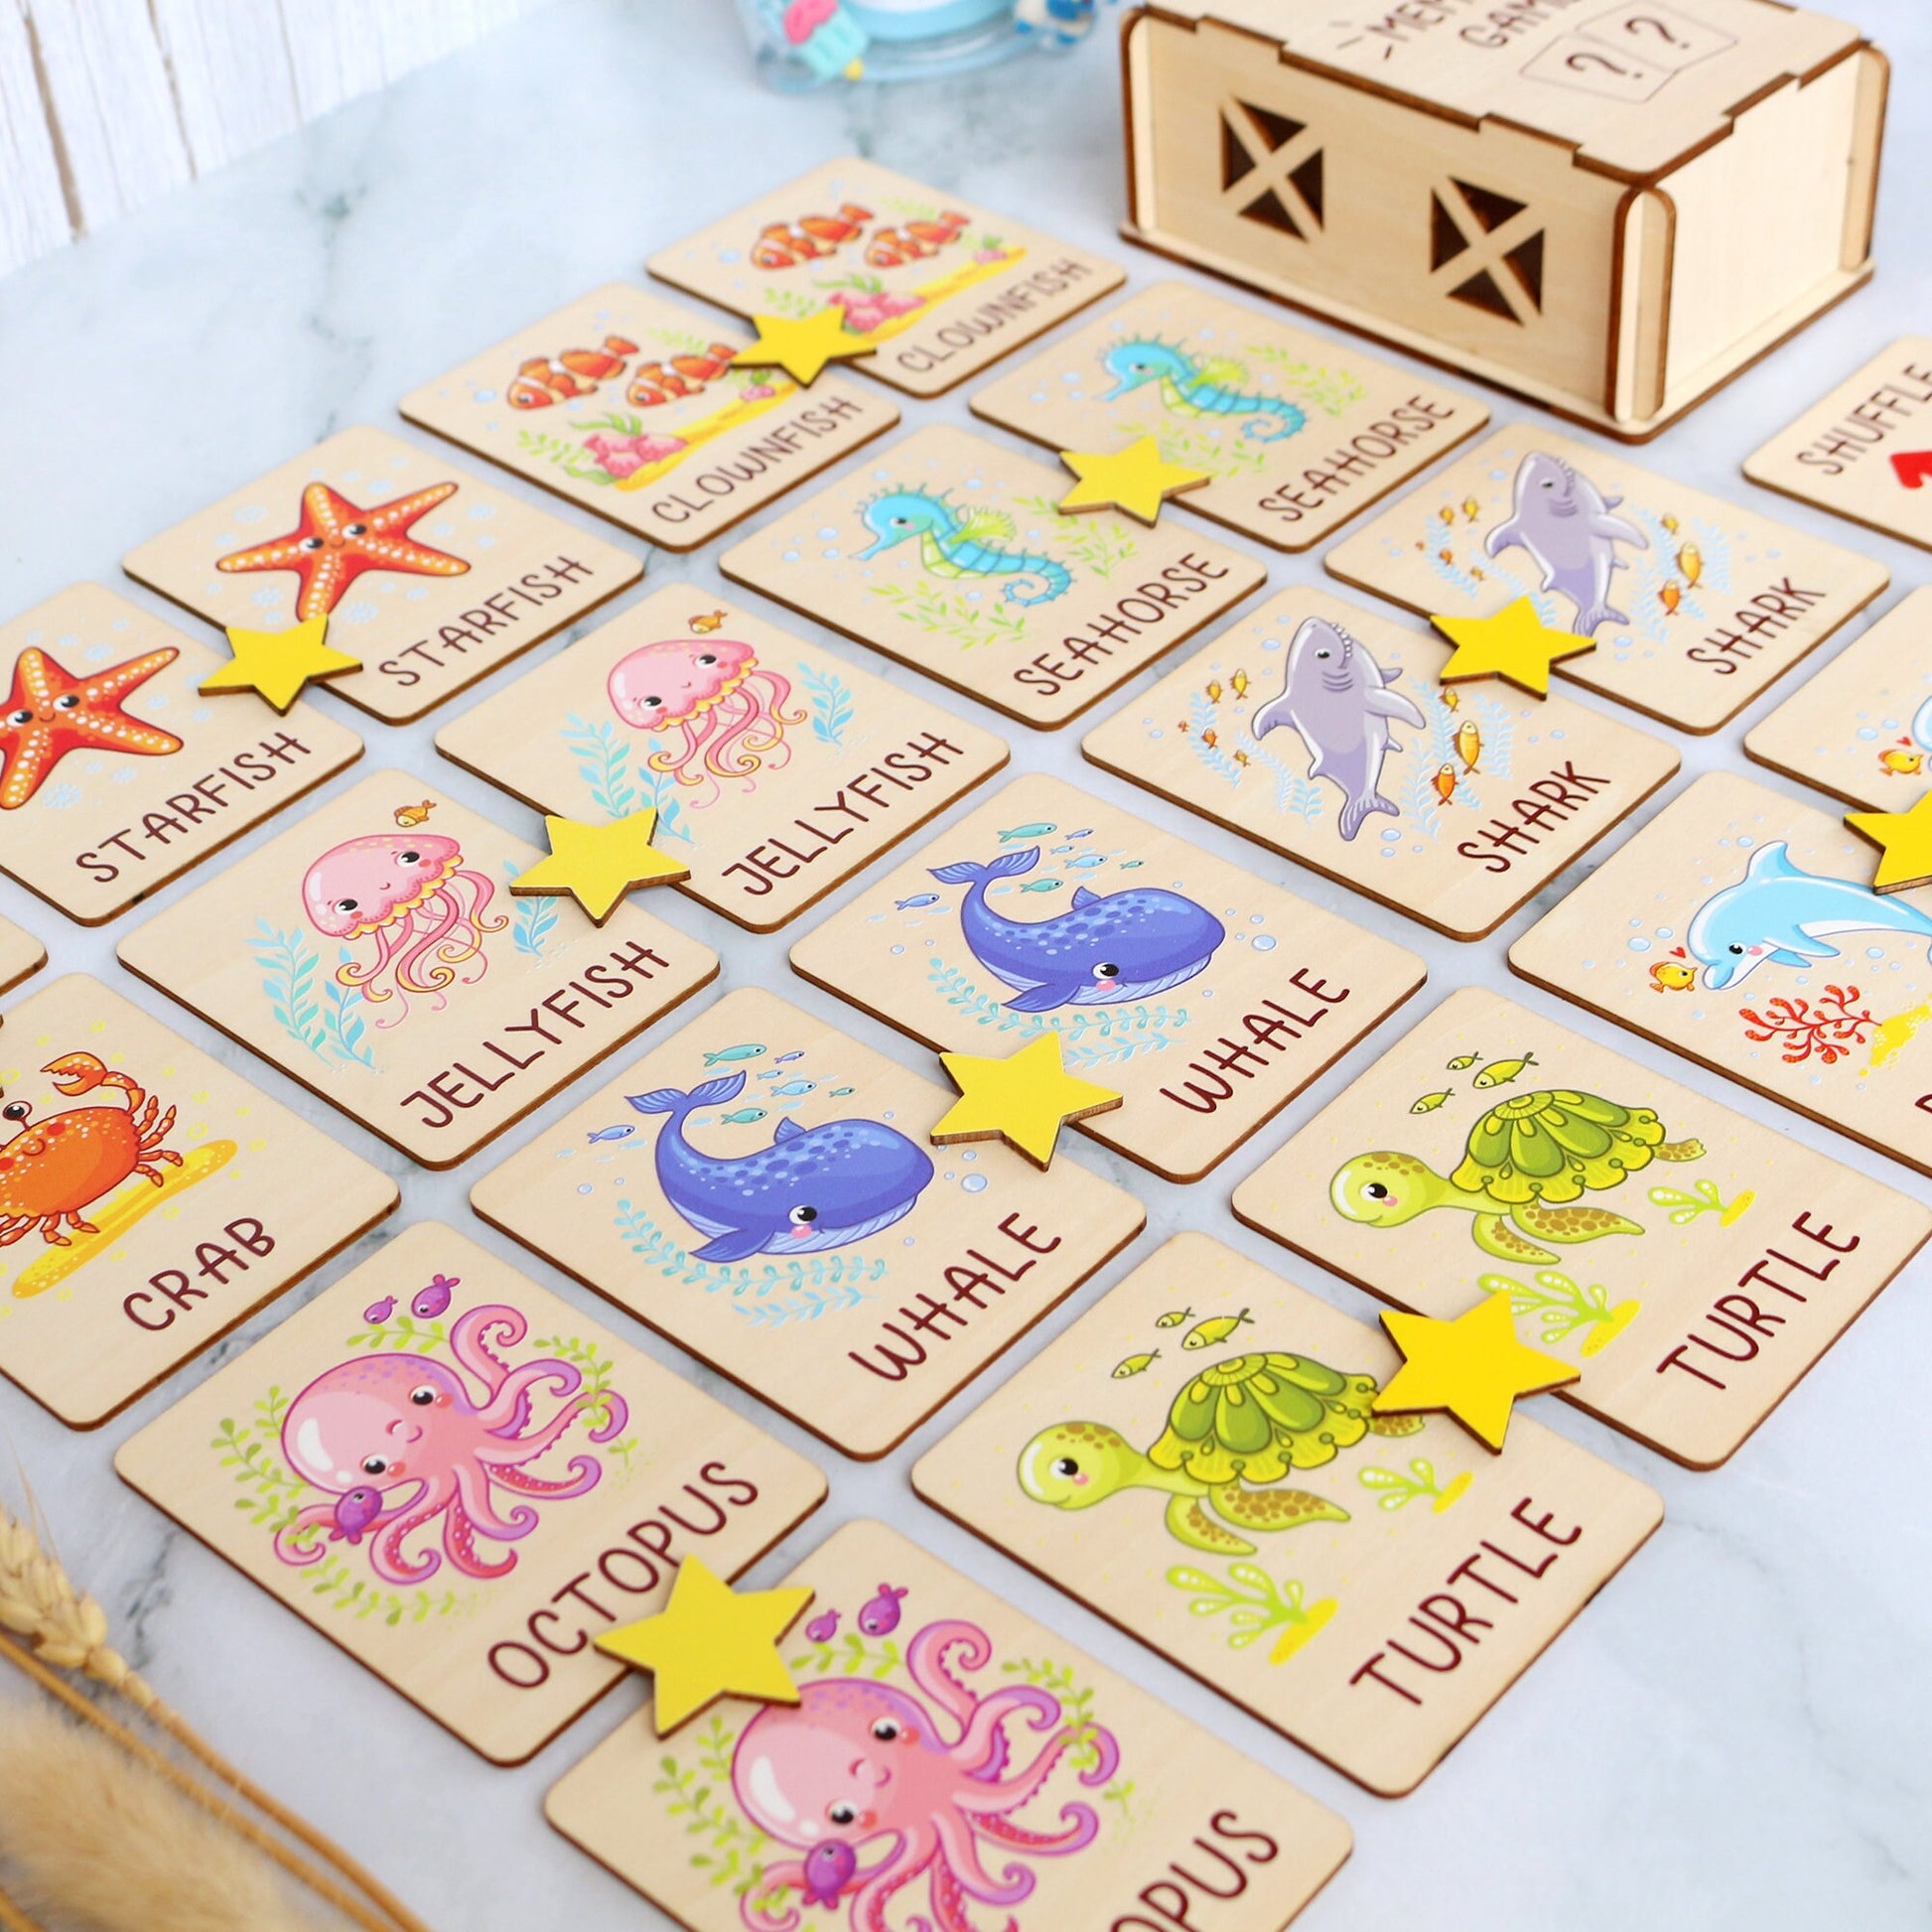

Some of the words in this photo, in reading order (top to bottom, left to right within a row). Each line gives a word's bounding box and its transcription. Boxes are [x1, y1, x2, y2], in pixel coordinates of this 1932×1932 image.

[897, 256, 1092, 372] CLOWNFISH
[652, 395, 863, 522] CLOWNFISH
[1259, 395, 1454, 521] SEAHORSE
[1796, 361, 1932, 476] SHUFFLE
[378, 555, 594, 686] STARFISH
[1014, 553, 1229, 696] SEAHORSE
[1687, 577, 1827, 675] SHARK
[76, 732, 311, 883] STARFISH
[722, 733, 964, 896] JELLYFISH
[1457, 761, 1611, 874] SHARK
[400, 941, 669, 1128] JELLYFISH
[1160, 968, 1351, 1114] WHALE
[123, 1218, 276, 1331] CRAB
[848, 1213, 1061, 1382] WHALE
[1656, 1211, 1861, 1390] TURTLE
[487, 1462, 759, 1689] OCTOPUS
[1350, 1497, 1583, 1706] TURTLE
